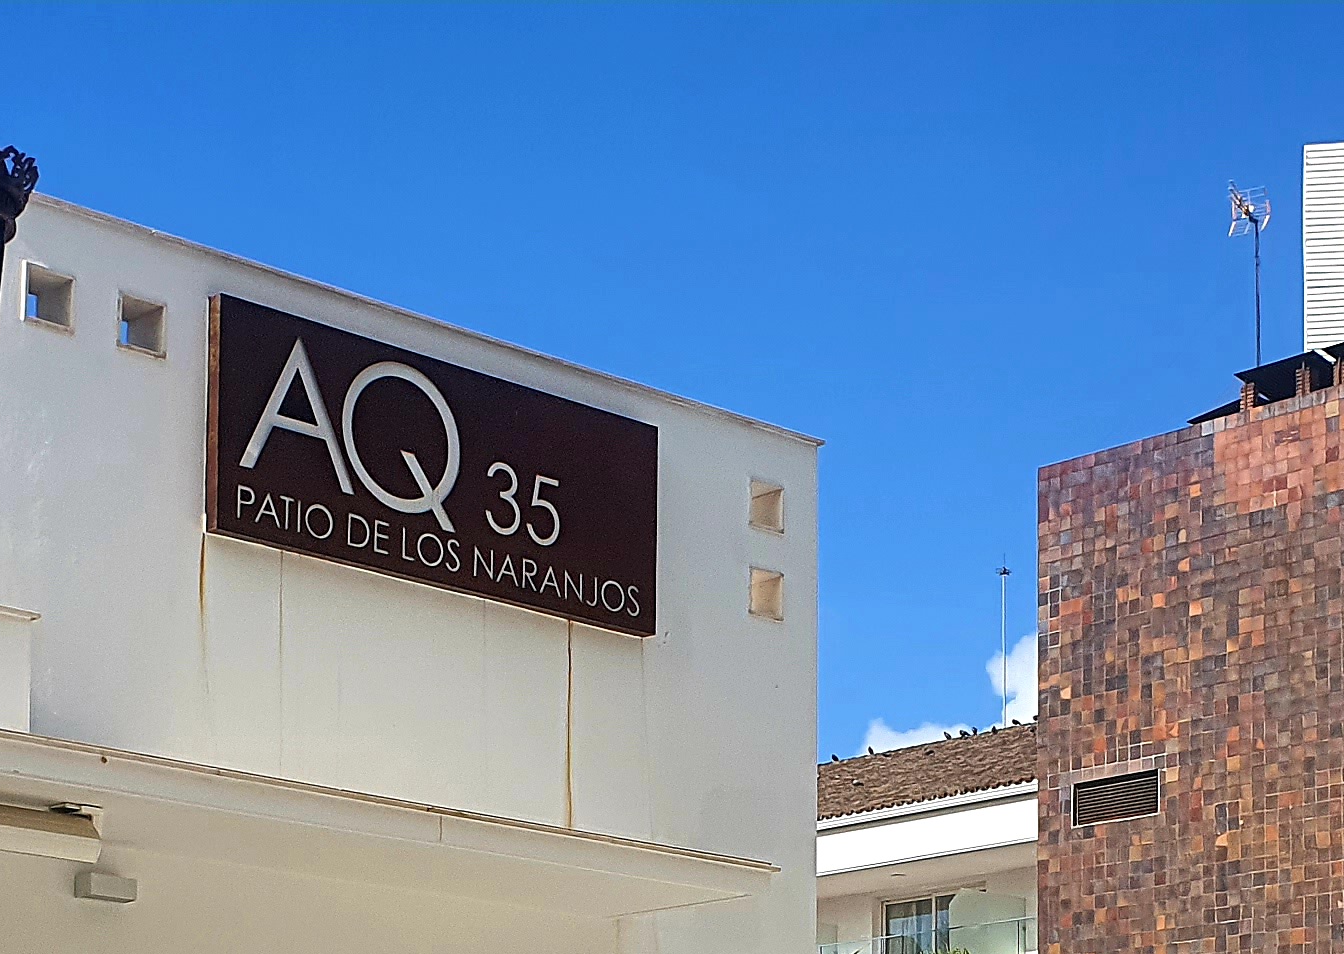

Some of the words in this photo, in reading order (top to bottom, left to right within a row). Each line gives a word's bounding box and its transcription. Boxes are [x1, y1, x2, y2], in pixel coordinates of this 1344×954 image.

[239, 336, 461, 533] AQ
[485, 461, 561, 548] 35
[237, 485, 333, 539] PATIO
[347, 514, 390, 556] DE
[401, 527, 461, 574] LOS
[472, 545, 642, 618] NARANJOS
